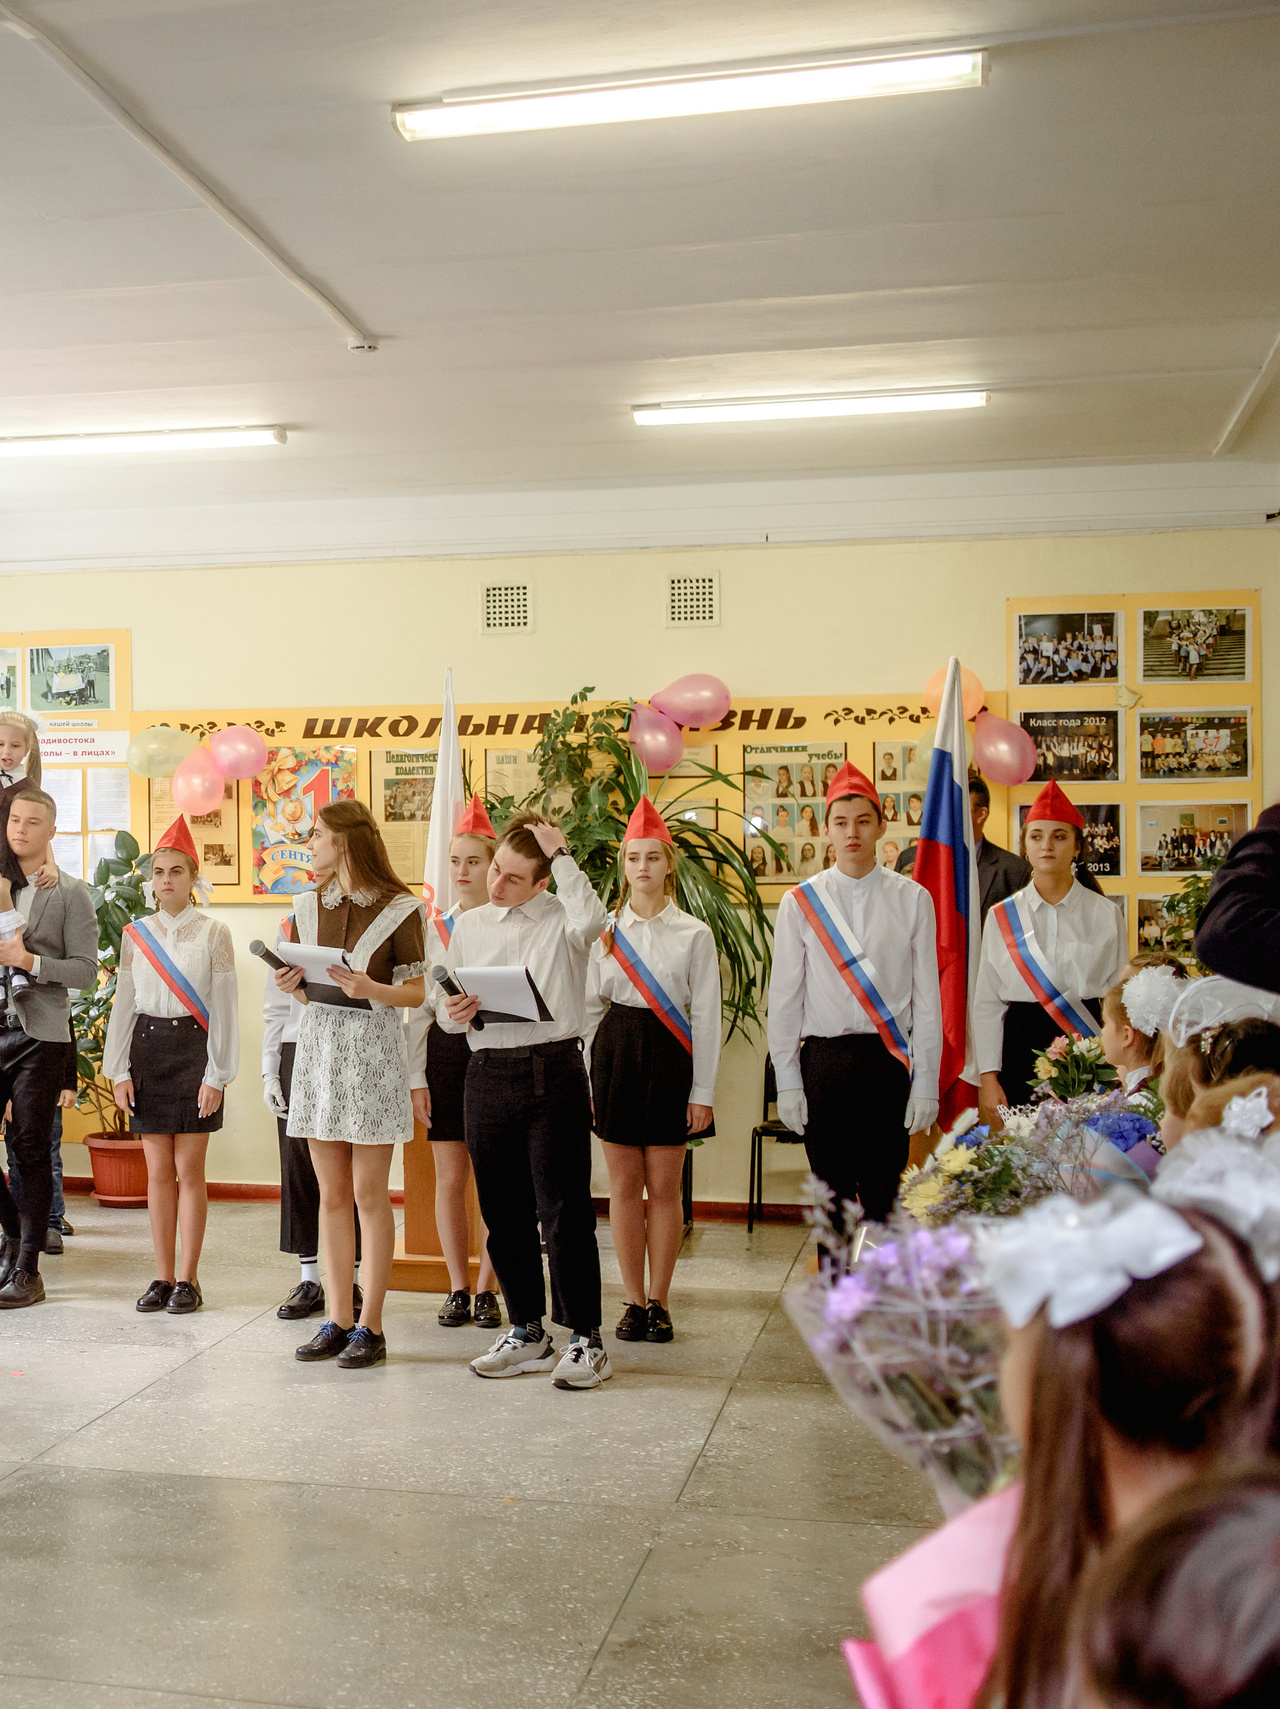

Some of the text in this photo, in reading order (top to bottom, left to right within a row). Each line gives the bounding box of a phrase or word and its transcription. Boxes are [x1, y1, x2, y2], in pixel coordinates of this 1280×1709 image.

[1029, 717, 1107, 728] Класс года 2012
[38, 737, 96, 745] адивостока
[744, 744, 808, 754] Отличники
[385, 750, 438, 764] Педагогическ
[808, 750, 843, 763] учебы
[395, 766, 434, 776] коллектив
[301, 766, 332, 828] 1
[271, 849, 313, 865] СЕНТЯ
[1087, 862, 1111, 872] 2013
